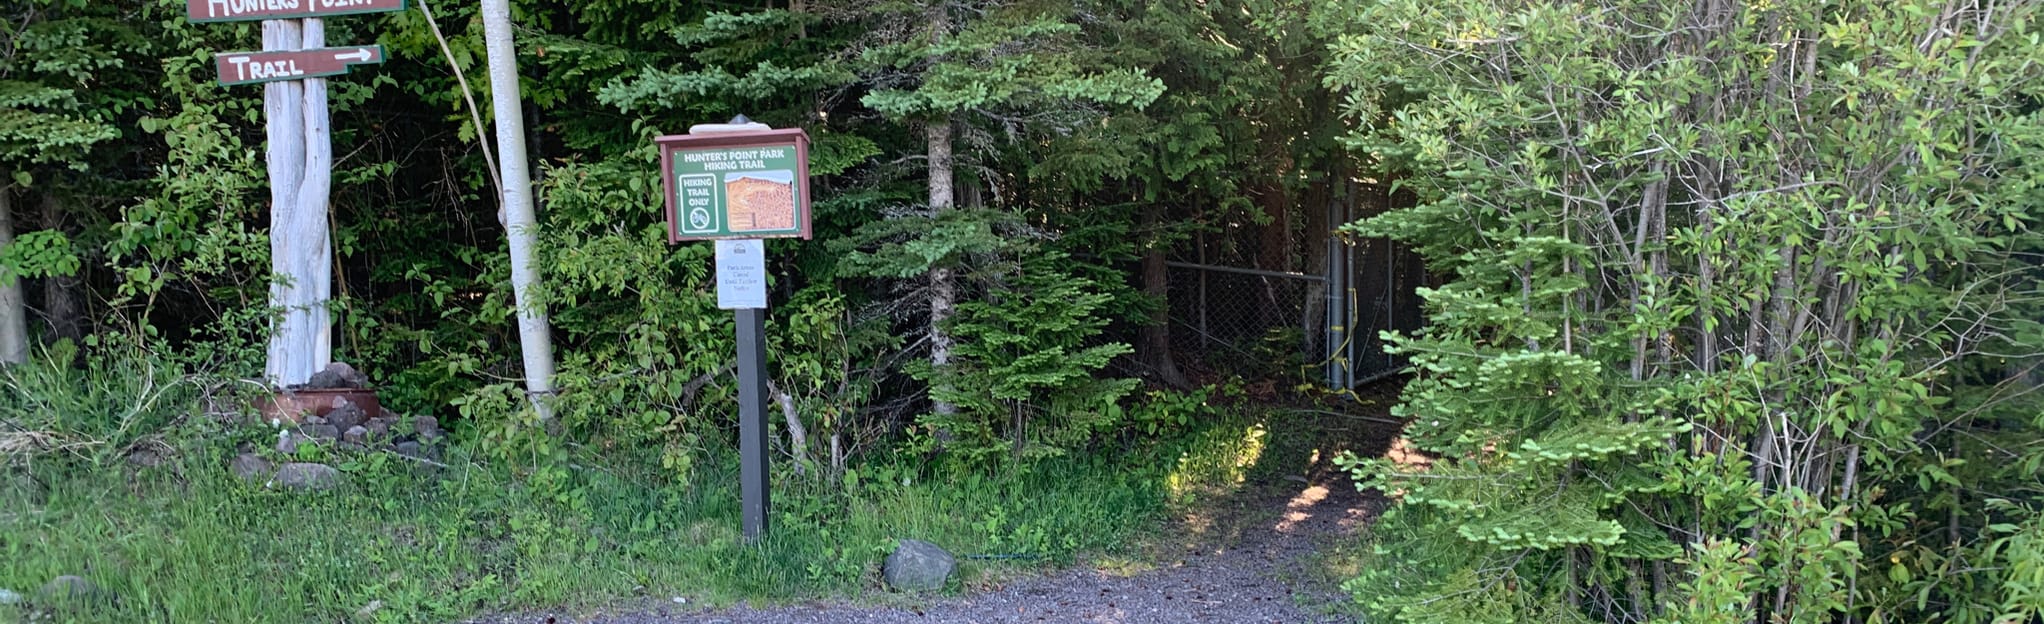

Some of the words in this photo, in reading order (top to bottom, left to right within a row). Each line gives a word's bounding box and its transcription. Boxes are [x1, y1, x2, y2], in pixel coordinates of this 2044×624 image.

[228, 56, 304, 81] TRAIL
[684, 151, 728, 162] HUNTER'S
[729, 150, 758, 160] POINT
[760, 149, 785, 159] PARK
[704, 161, 737, 171] HIKING
[740, 160, 766, 169] TRAIL
[683, 178, 712, 188] HIKING
[687, 188, 710, 197] TRAIL
[688, 198, 710, 207] ONLY
